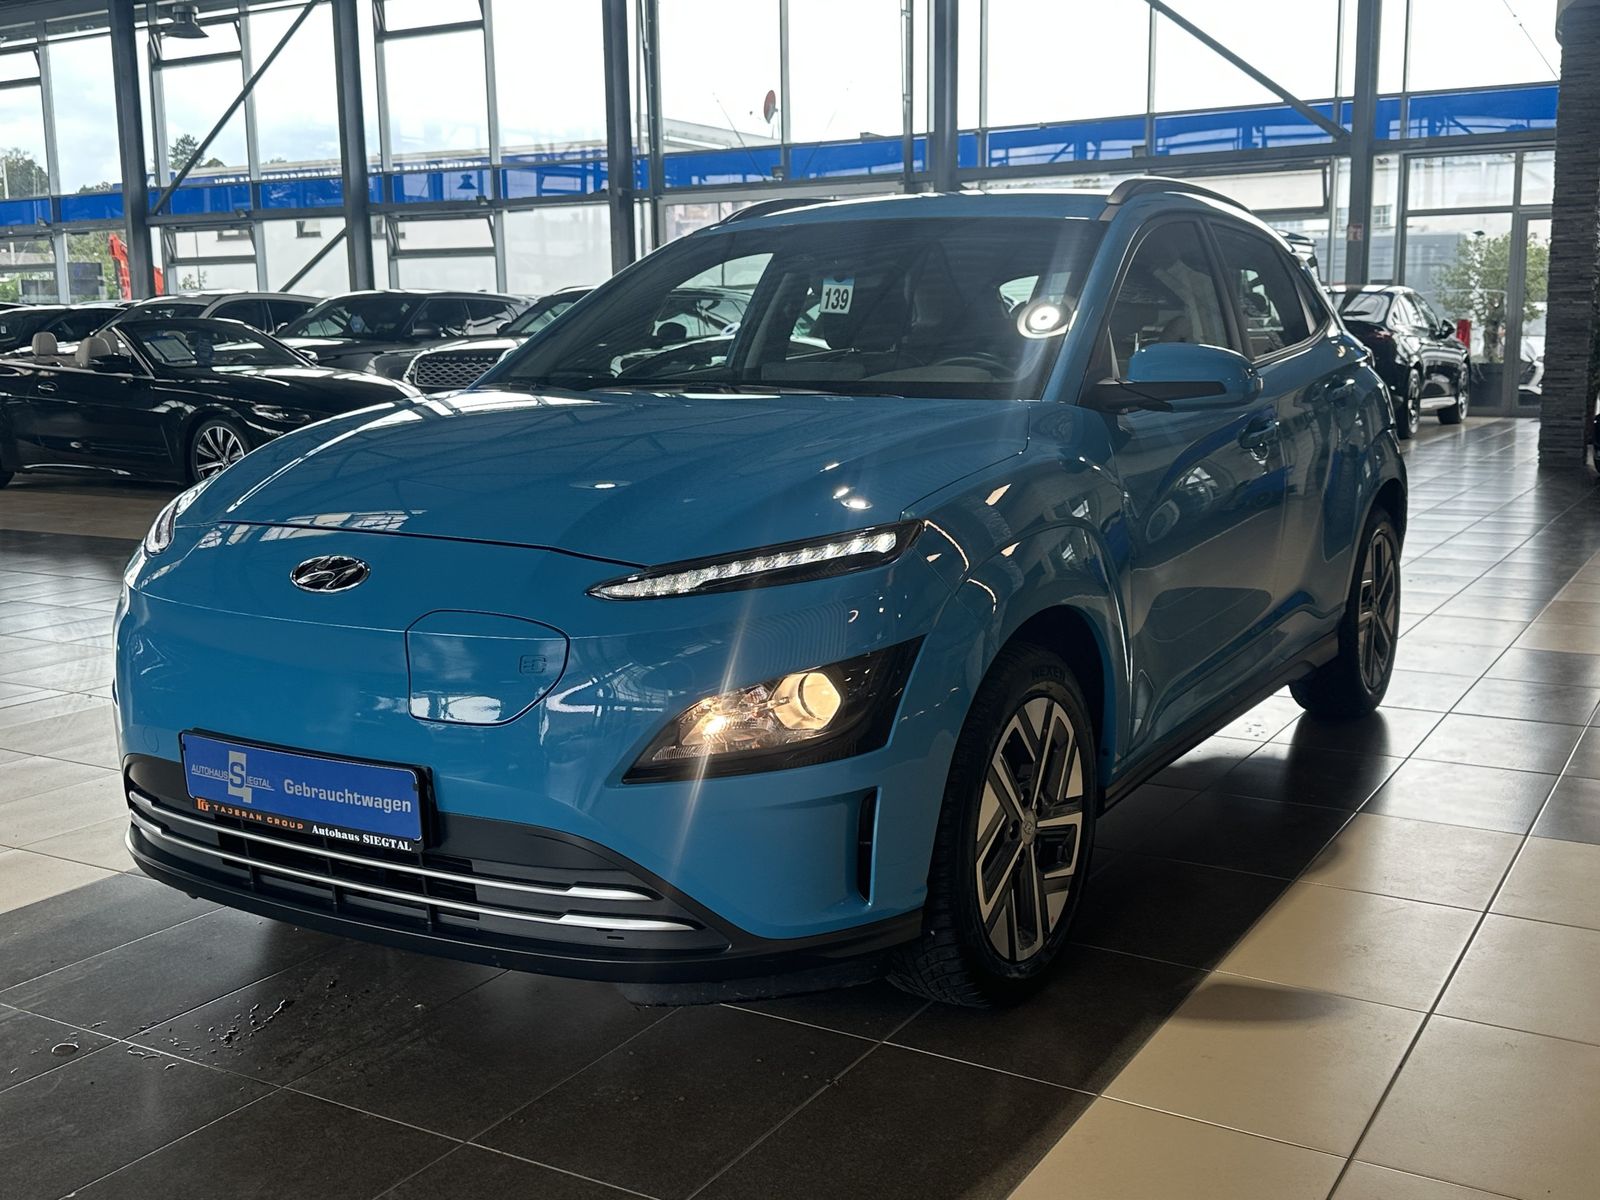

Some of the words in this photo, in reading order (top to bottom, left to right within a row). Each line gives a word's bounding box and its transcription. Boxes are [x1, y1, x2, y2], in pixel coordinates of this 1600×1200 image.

[825, 288, 849, 310] 139
[191, 764, 229, 780] AUTOHAUS
[283, 779, 412, 814] Gebrauchtwagen
[266, 816, 304, 830] GROUP
[311, 825, 360, 842] Autohaus
[362, 833, 412, 851] SIEGTAL
